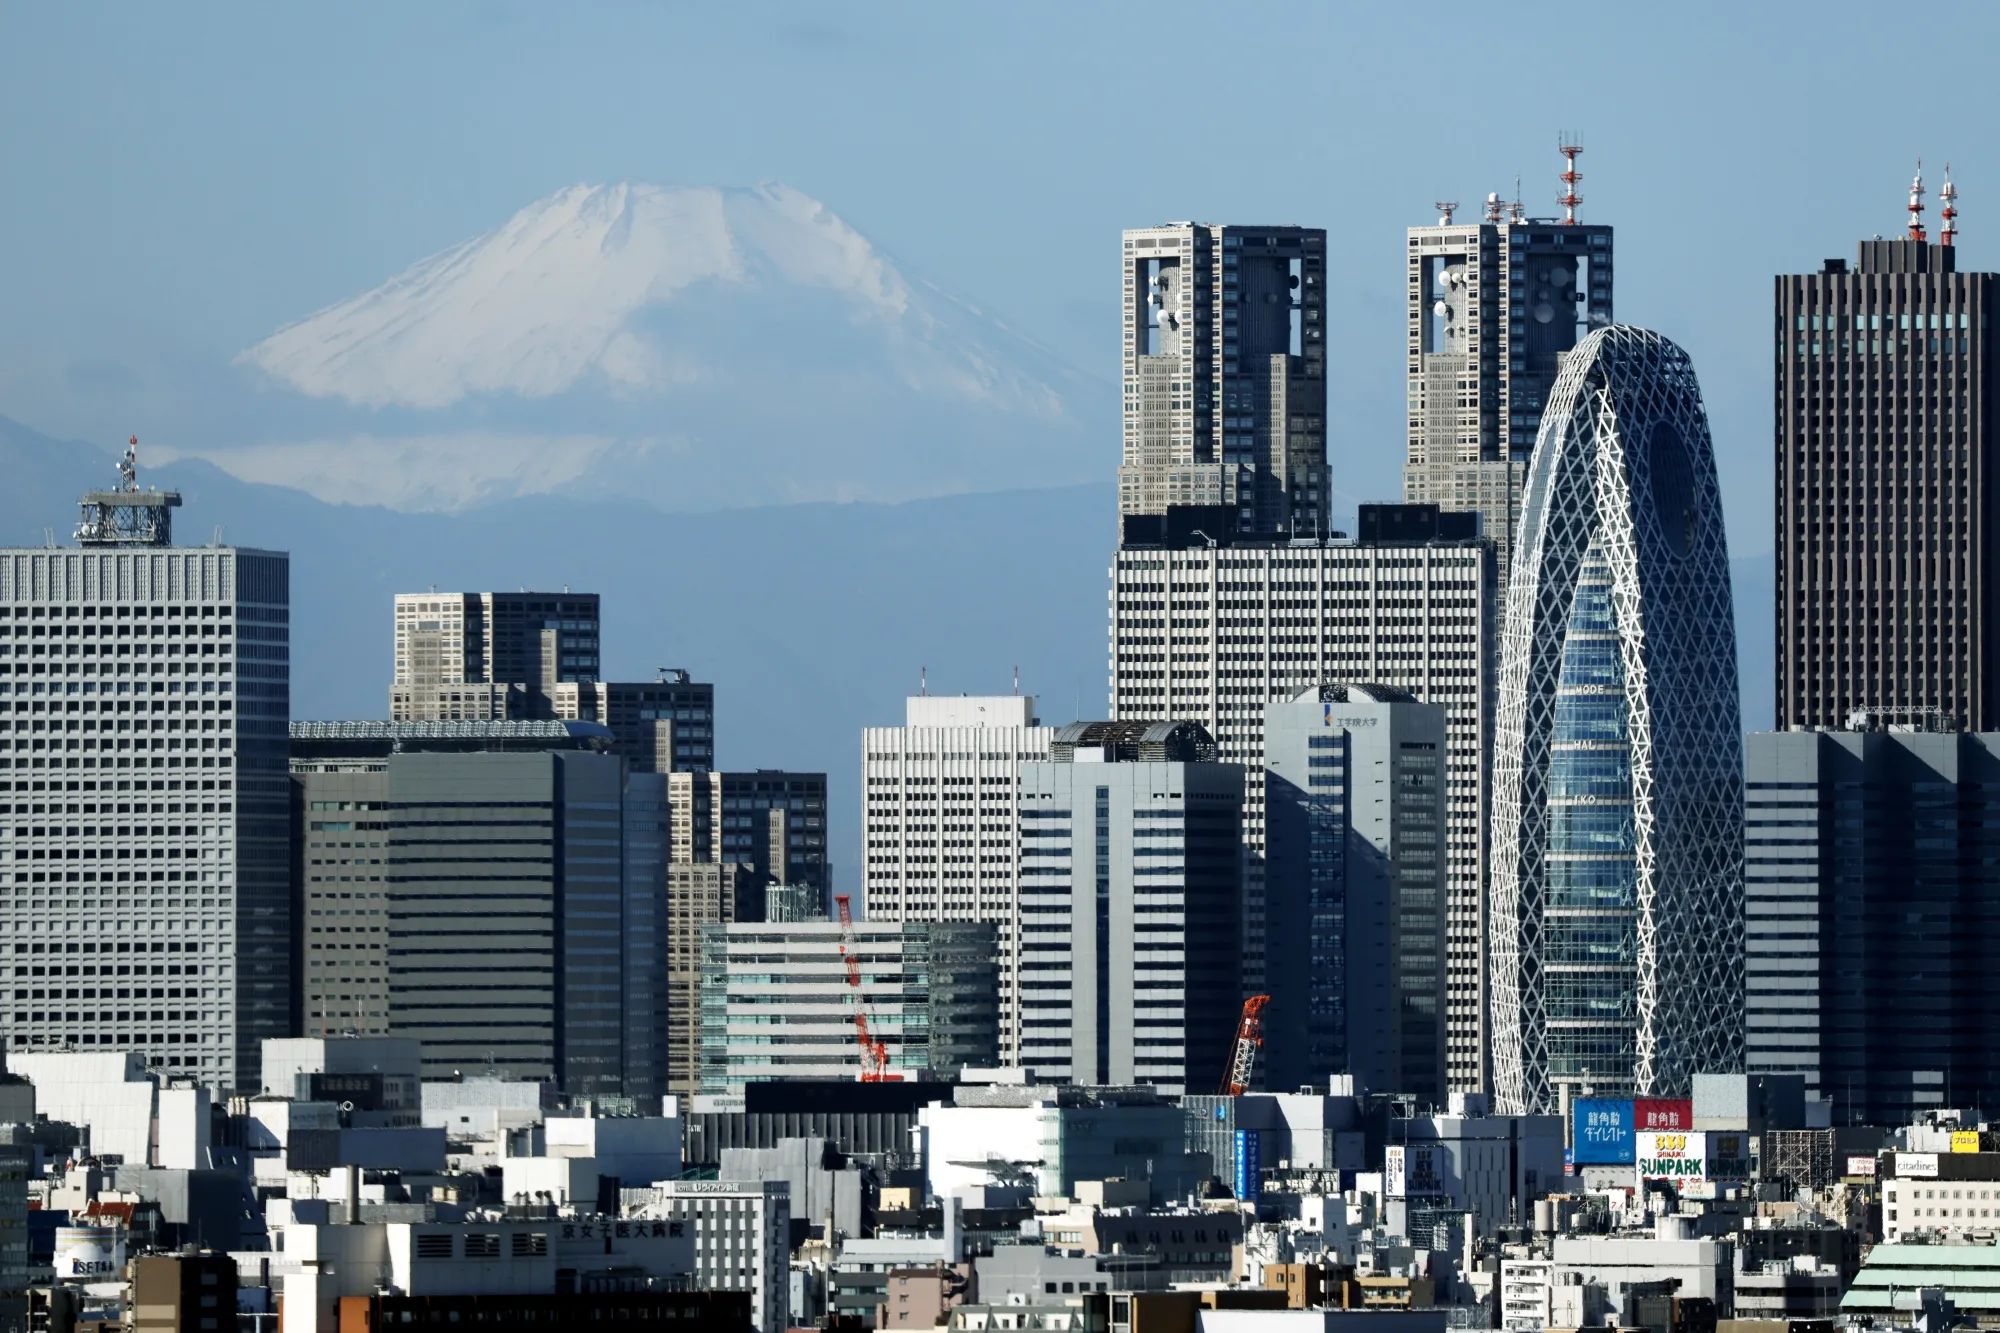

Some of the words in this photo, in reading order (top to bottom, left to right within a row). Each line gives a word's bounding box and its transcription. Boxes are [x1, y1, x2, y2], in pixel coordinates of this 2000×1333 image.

[1576, 684, 1604, 695] MODE
[1337, 718, 1378, 727] 工学院大学
[1574, 739, 1597, 750] HAL
[1588, 1111, 1620, 1126] 龍角散
[1647, 1111, 1679, 1126] 龍角散
[1584, 1127, 1626, 1142] ダイレクト
[1639, 1158, 1703, 1175] SUNPARK
[1897, 1160, 1937, 1171] citadines
